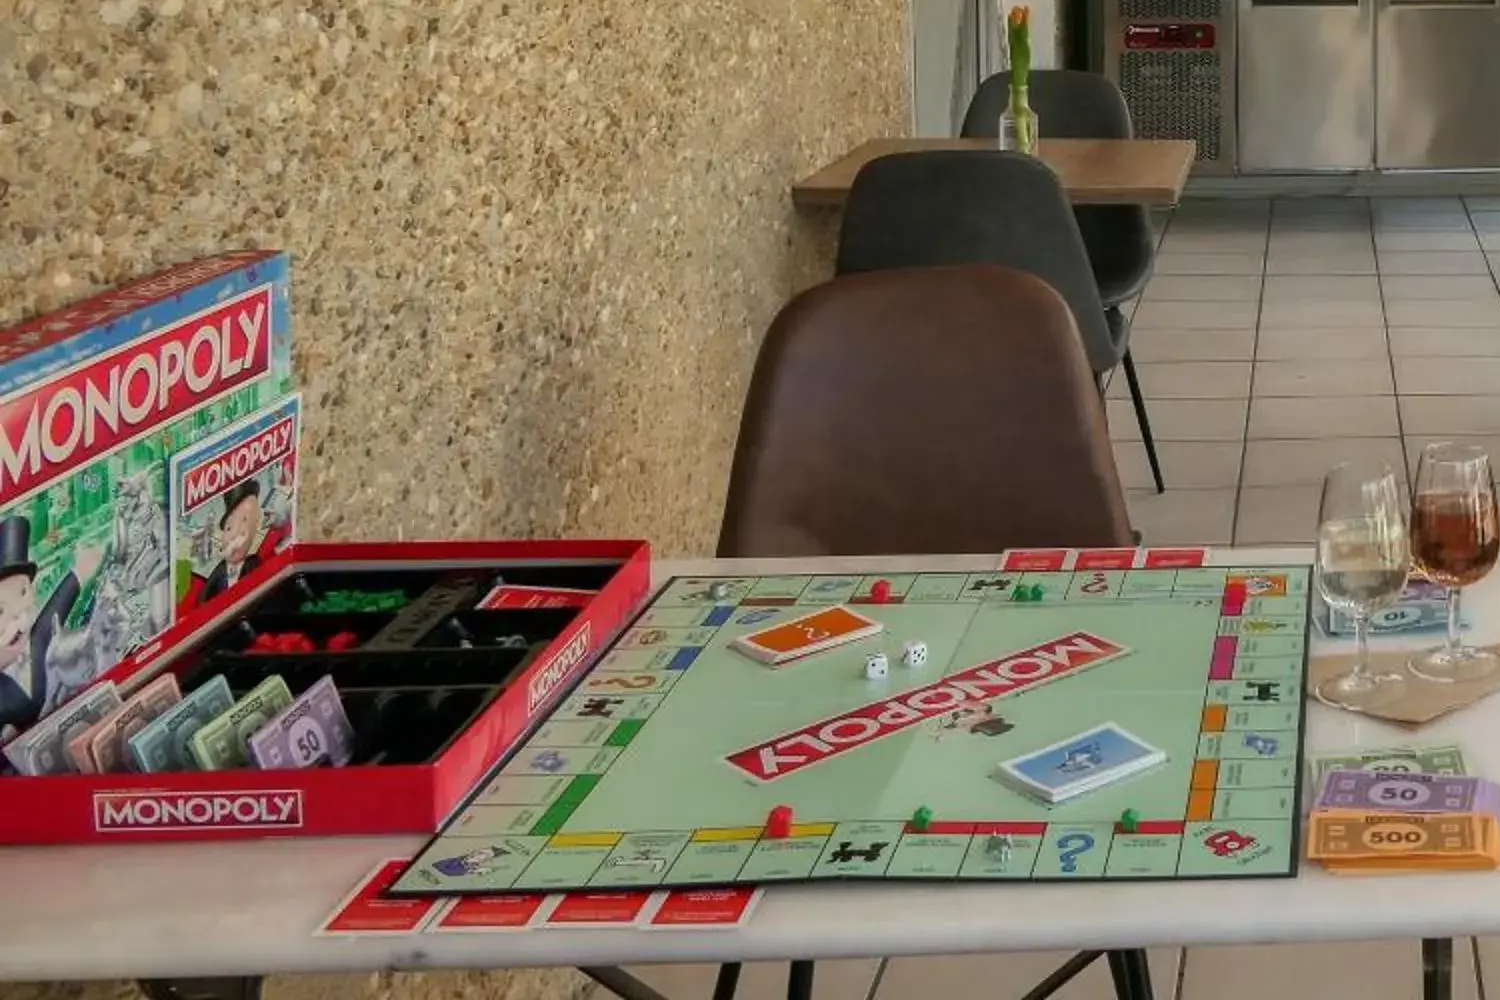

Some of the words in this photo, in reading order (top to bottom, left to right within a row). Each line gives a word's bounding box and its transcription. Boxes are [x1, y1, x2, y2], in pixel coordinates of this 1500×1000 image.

[0, 302, 265, 493] MONOPOLY
[187, 420, 293, 506] MONOPOLY
[530, 628, 589, 711] MONOPOLY
[759, 636, 1104, 775] MONOPOLY
[299, 729, 322, 763] 50
[103, 796, 296, 826] MONOPOLY
[1380, 787, 1418, 800] 50
[1370, 830, 1422, 844] 500
